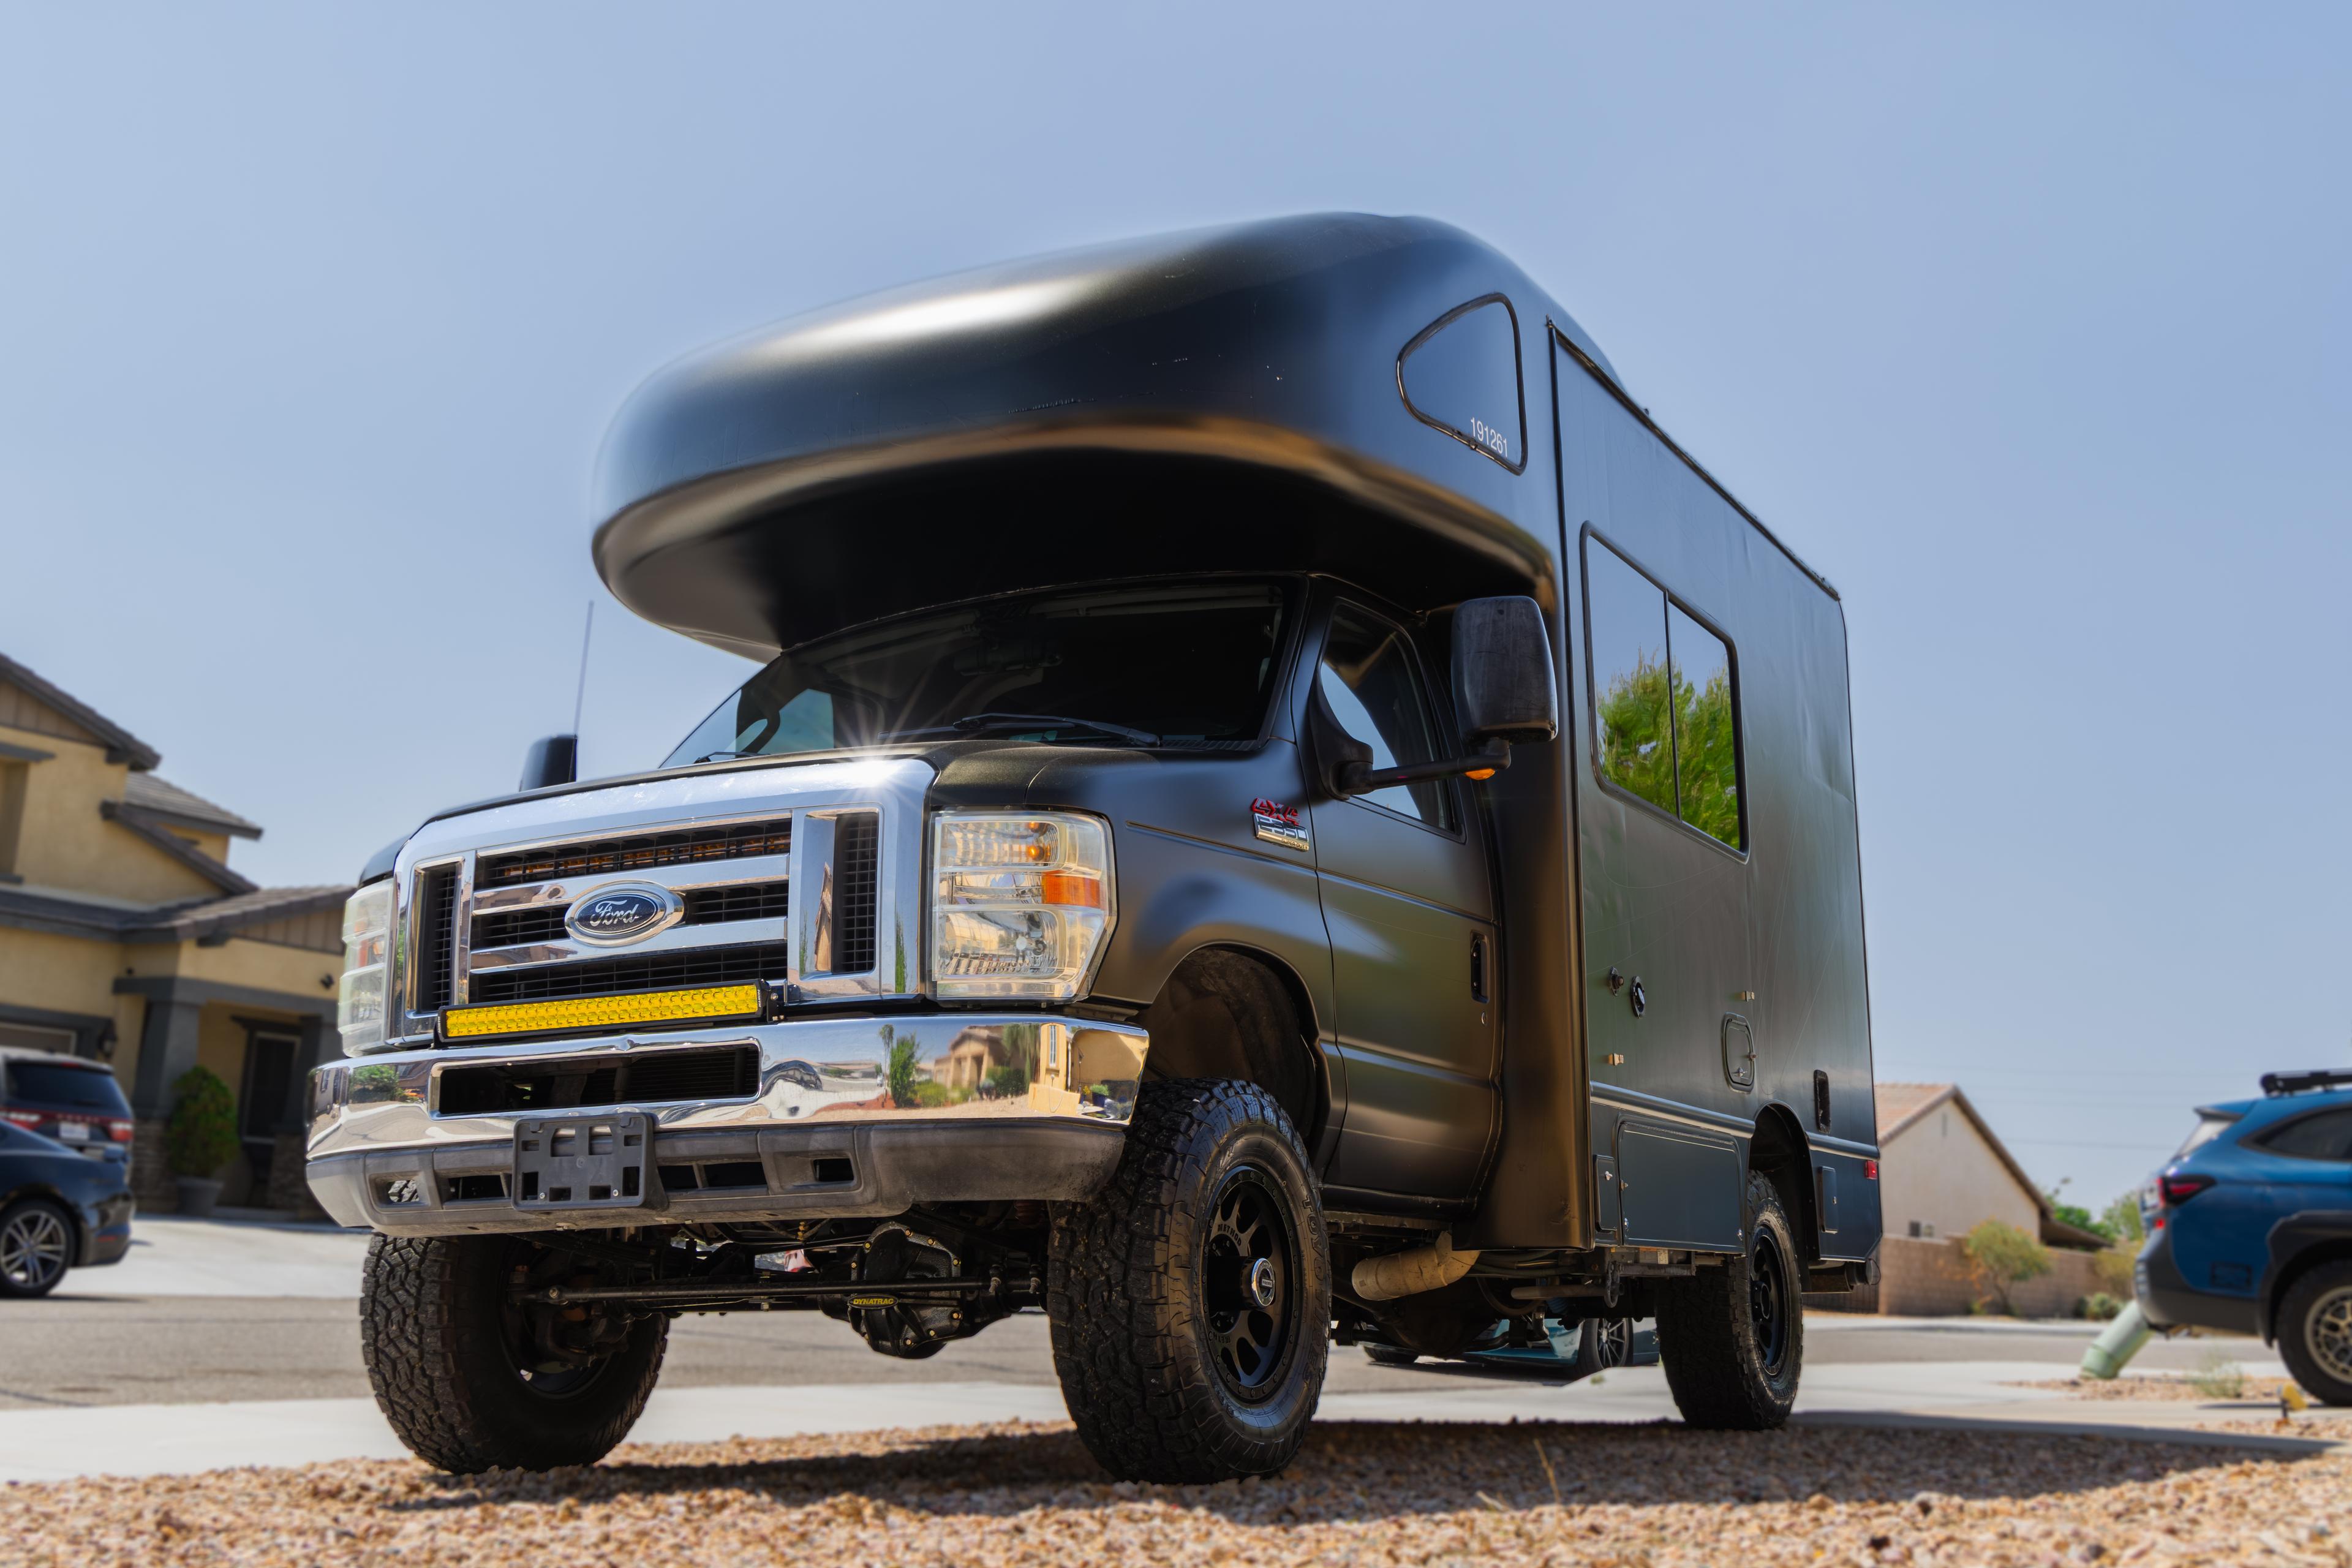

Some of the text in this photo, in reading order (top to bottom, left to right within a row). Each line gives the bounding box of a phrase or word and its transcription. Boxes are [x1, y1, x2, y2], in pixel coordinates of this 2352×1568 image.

[1471, 417, 1507, 457] 191261
[1281, 838, 1295, 846] SUPER
[590, 899, 642, 927] Ford
[1217, 1223, 1242, 1246] METHOD
